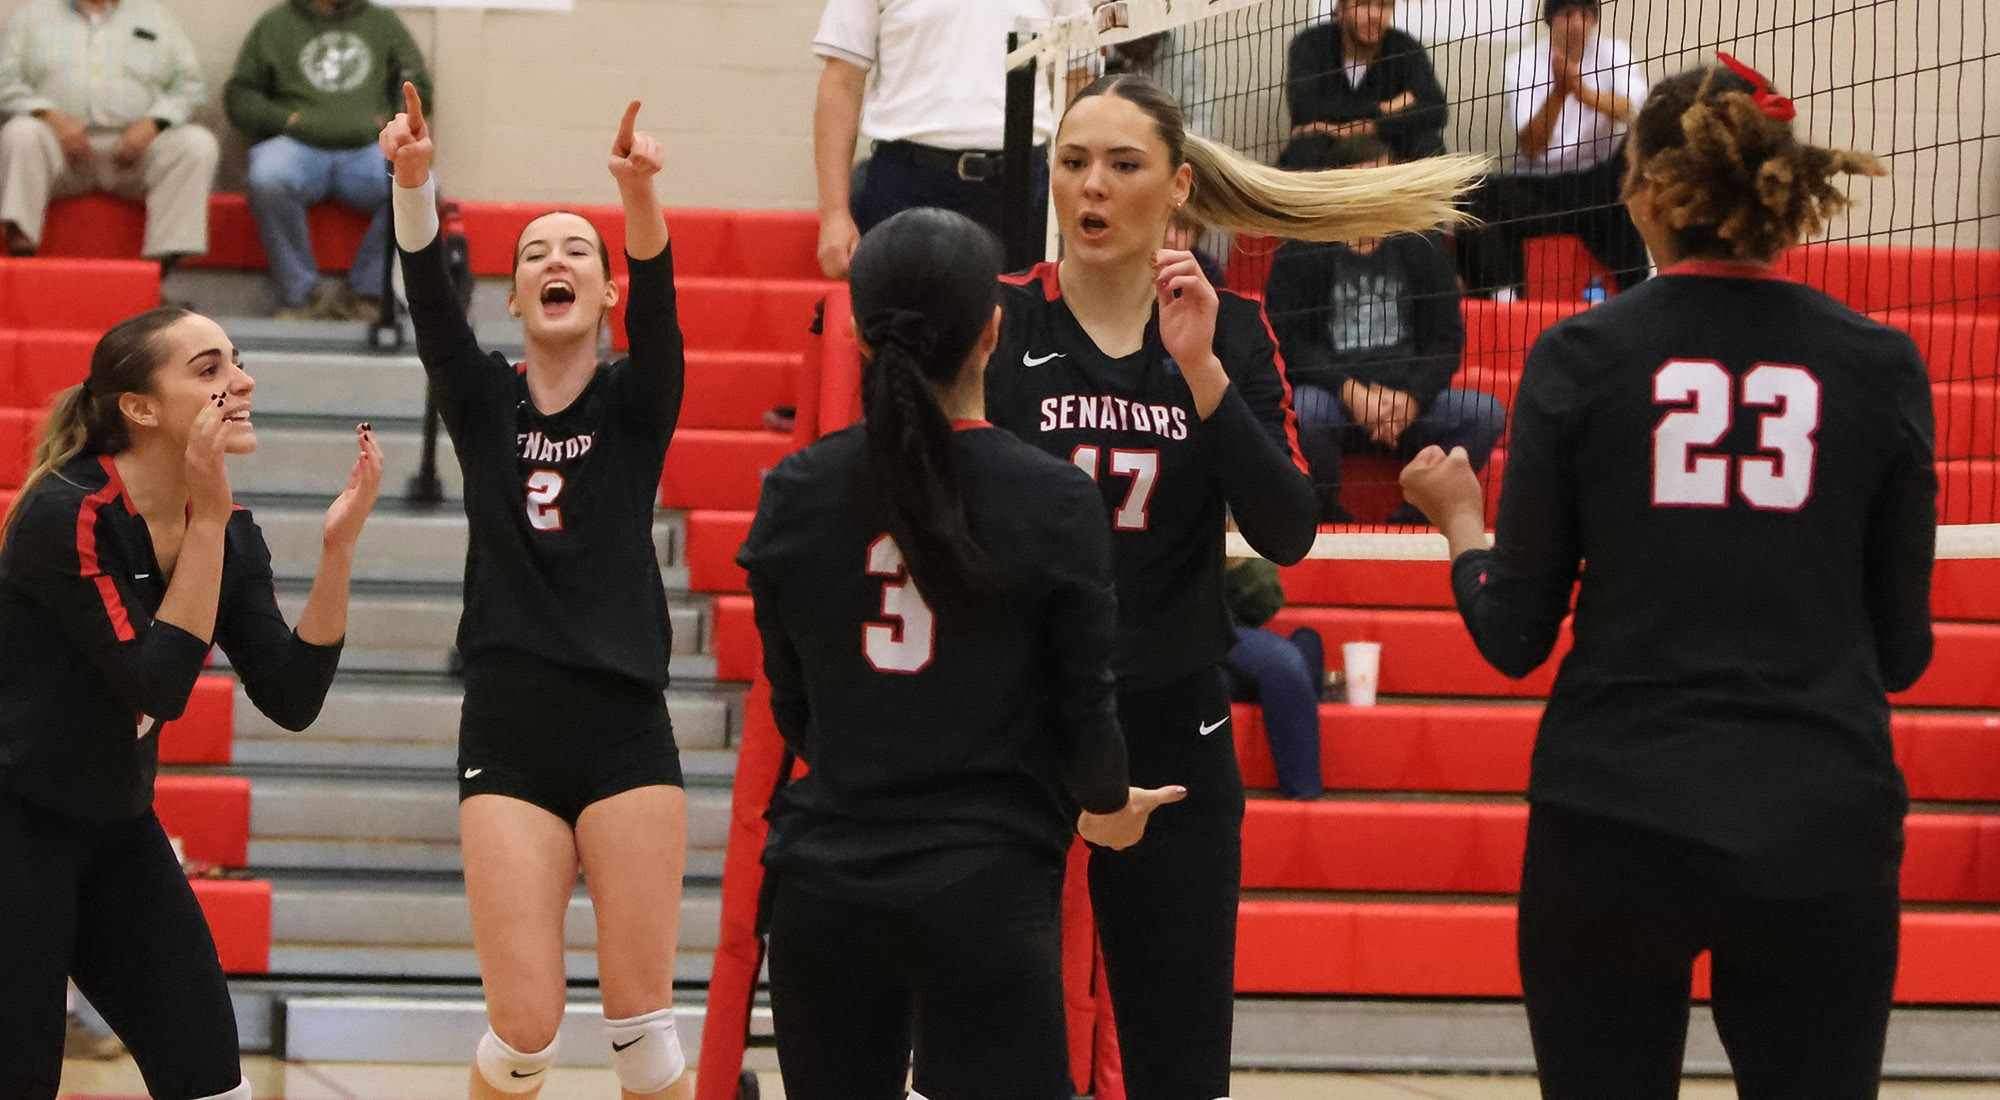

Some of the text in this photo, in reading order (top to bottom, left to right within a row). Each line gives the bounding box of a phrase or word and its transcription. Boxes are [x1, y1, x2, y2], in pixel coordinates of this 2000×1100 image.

[1040, 394, 1188, 440] SENATORS
[1651, 357, 1823, 513] 23
[526, 468, 565, 531] 2
[861, 531, 937, 674] 3
